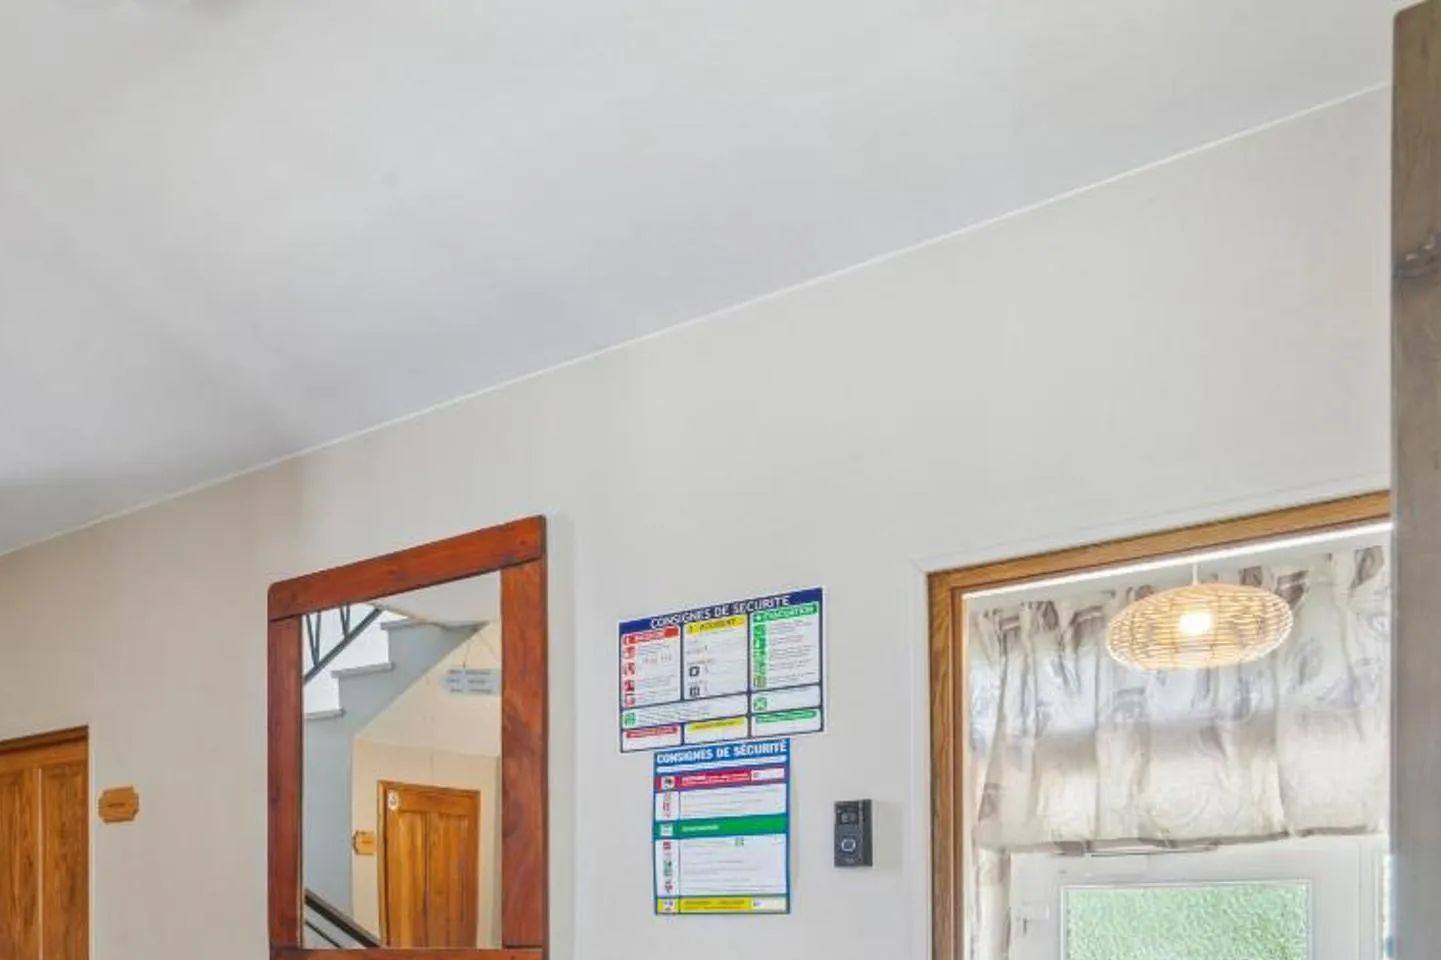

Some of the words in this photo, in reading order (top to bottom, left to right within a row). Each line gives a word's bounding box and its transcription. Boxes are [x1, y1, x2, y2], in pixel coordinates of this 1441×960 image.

[650, 608, 711, 629] CONSIGNES
[714, 604, 729, 617] DE
[656, 748, 714, 764] CONSIGNES
[716, 746, 731, 758] DE
